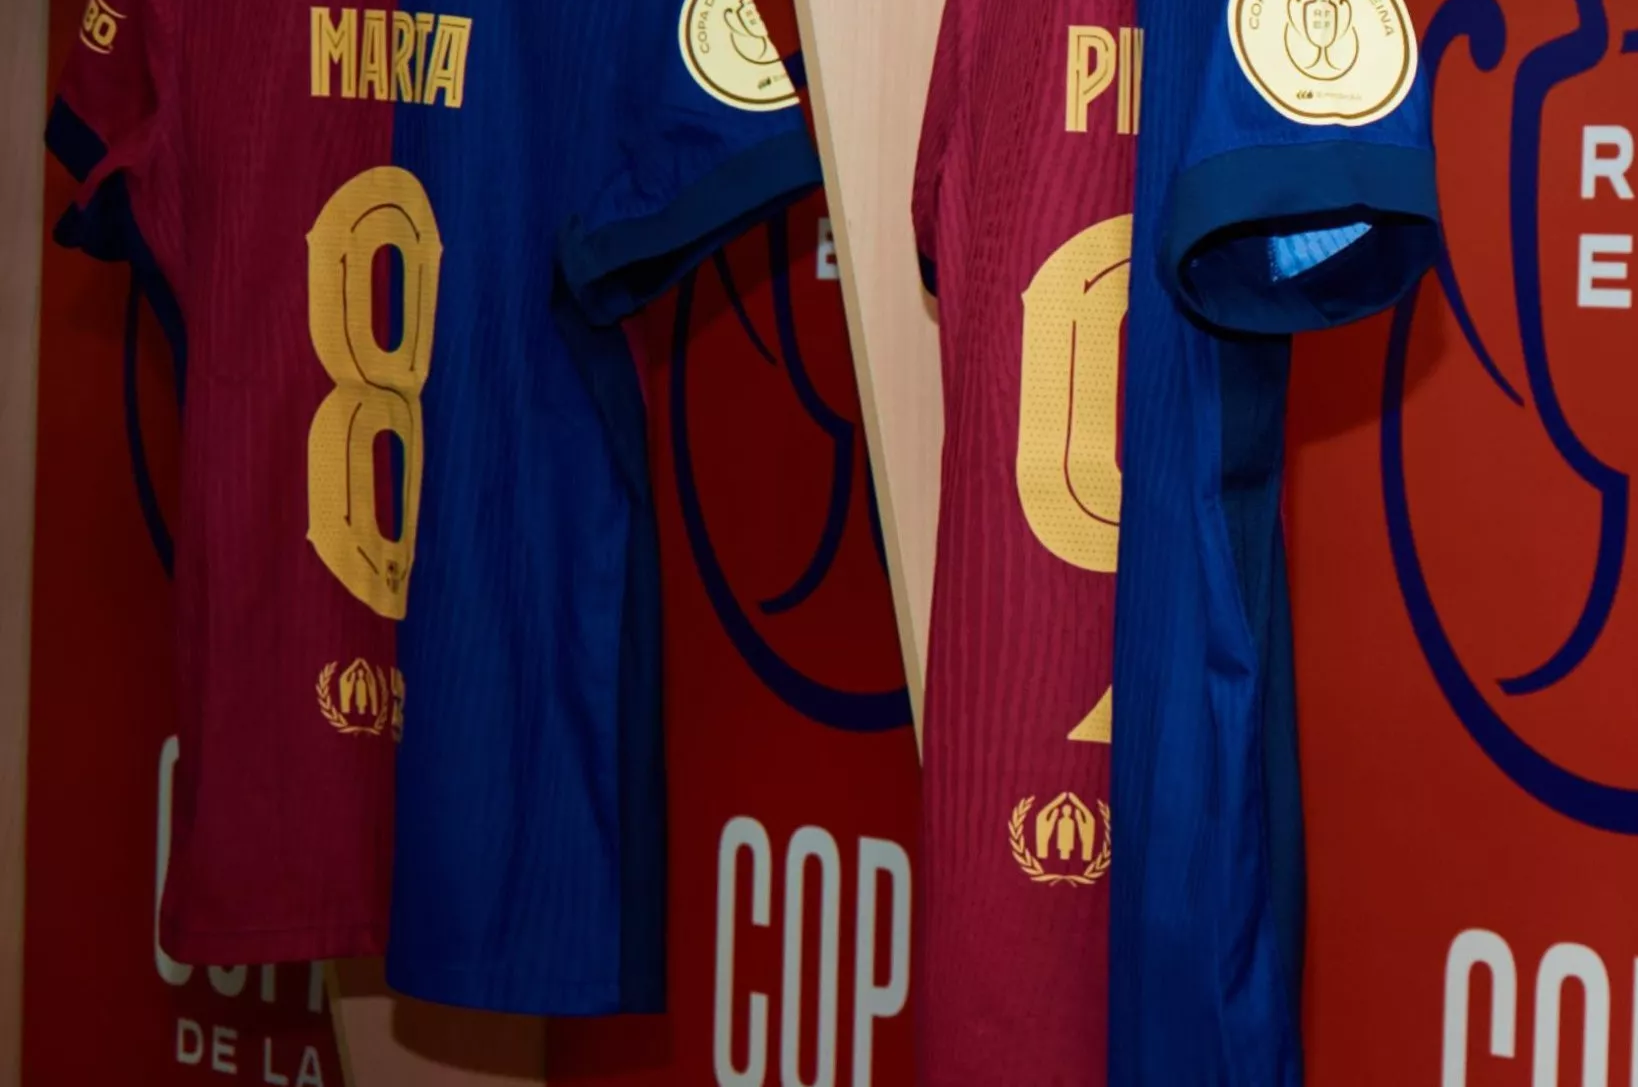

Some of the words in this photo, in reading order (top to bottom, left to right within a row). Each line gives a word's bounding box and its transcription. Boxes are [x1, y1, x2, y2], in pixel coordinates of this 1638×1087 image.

[310, 6, 473, 109] MARTA
[697, 10, 711, 54] COPA
[306, 165, 443, 621] 8
[713, 815, 912, 1087] COP
[175, 1017, 238, 1075] DE
[262, 1036, 325, 1087] LA
